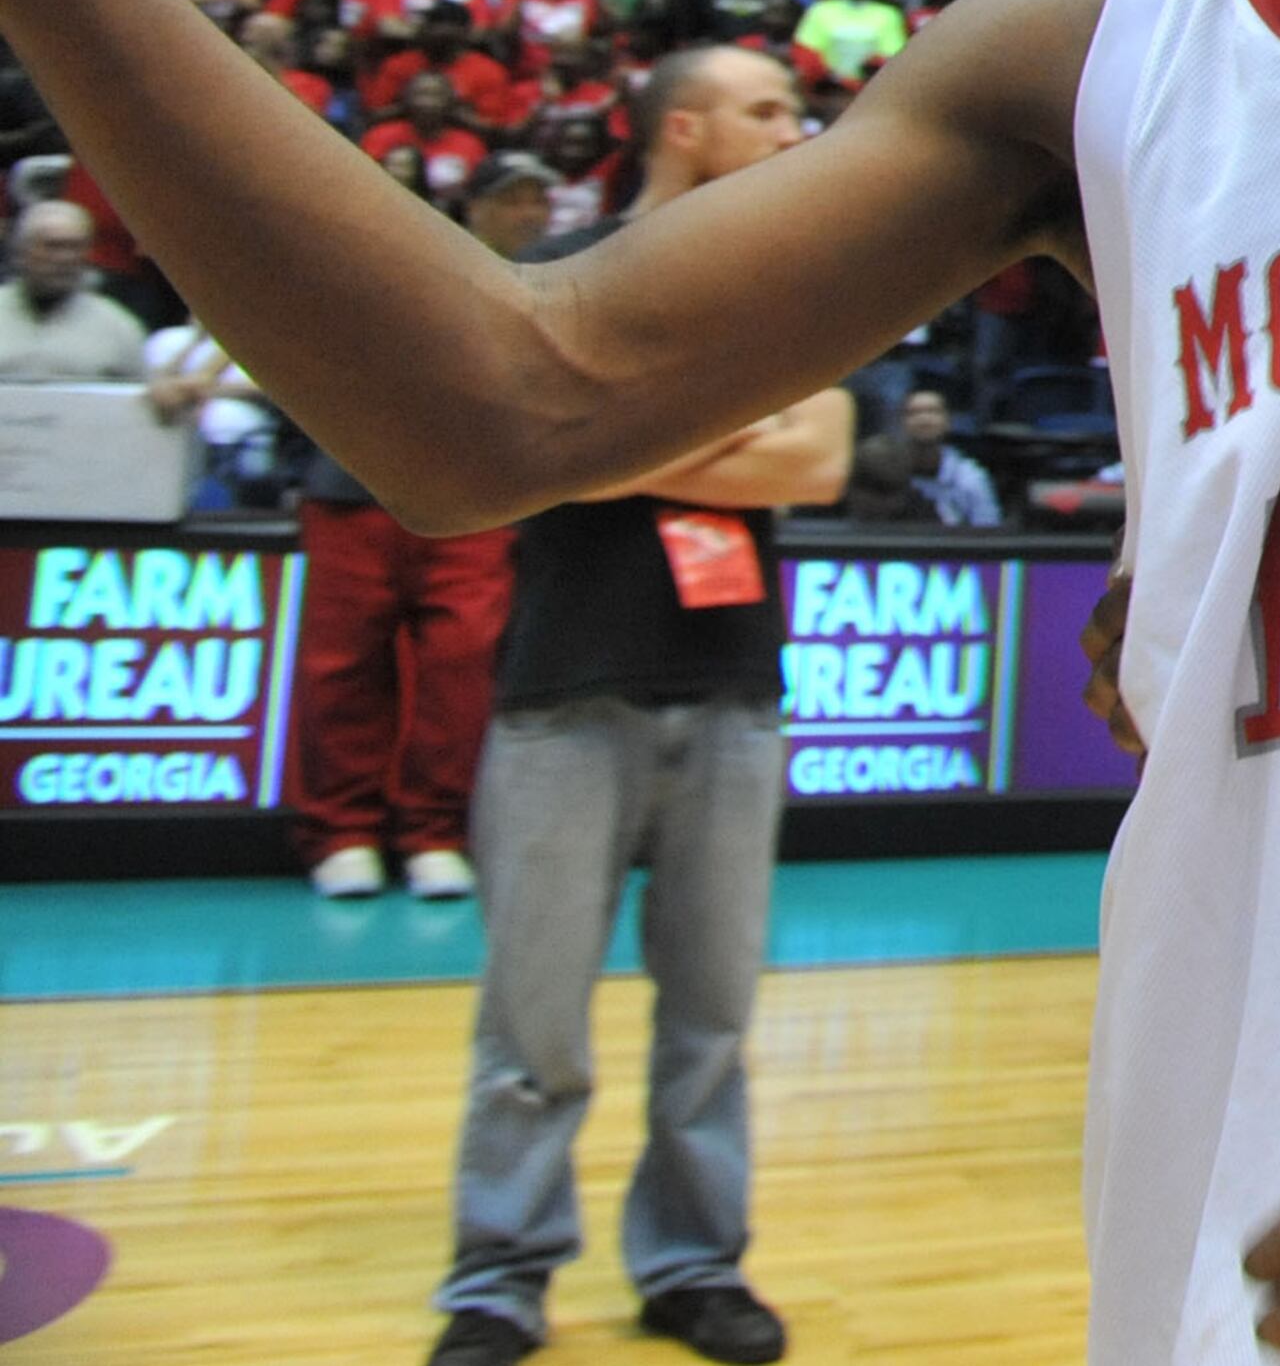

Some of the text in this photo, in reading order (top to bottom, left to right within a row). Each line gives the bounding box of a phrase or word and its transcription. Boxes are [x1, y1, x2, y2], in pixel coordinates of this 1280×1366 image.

[29, 547, 264, 631] FARM
[793, 560, 990, 636] FARM
[779, 641, 990, 719] REAU
[17, 752, 248, 804] GEORGIA
[789, 745, 984, 795] GEORGIA
